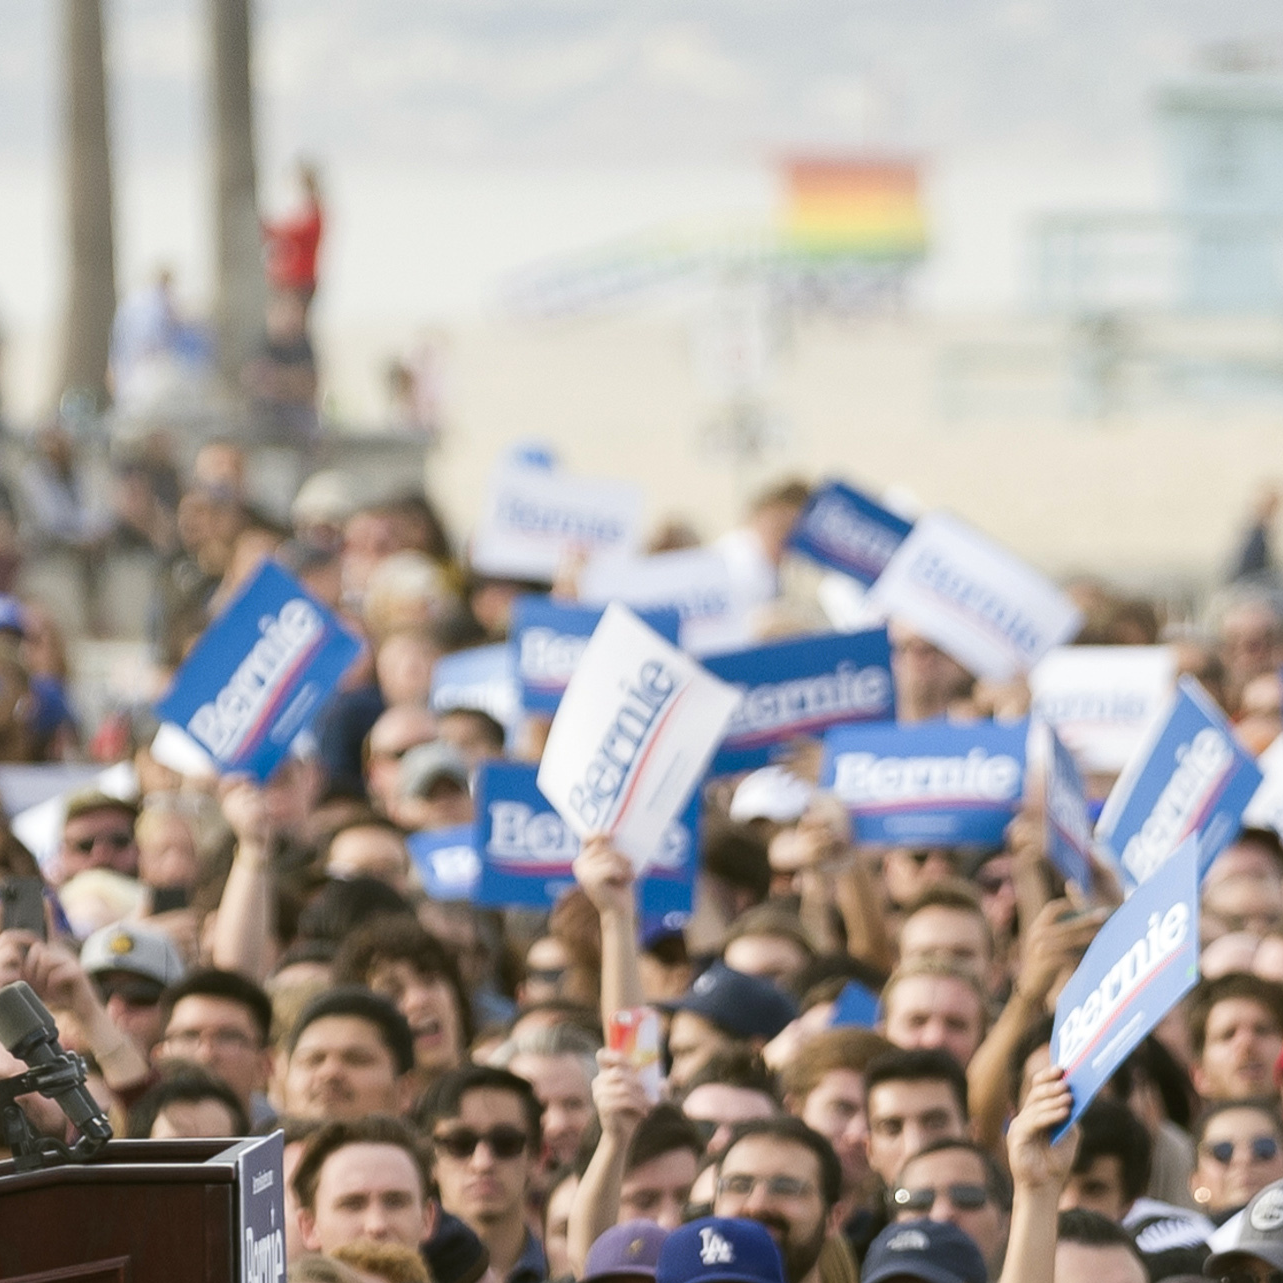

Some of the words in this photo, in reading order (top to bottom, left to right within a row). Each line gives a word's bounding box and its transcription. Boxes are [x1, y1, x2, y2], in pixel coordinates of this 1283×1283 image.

[187, 598, 326, 761] Bernie
[570, 659, 677, 827] Bernie
[834, 748, 1020, 803] Bernie
[1122, 727, 1233, 885] Bernie
[1058, 901, 1189, 1070] Bernie
[698, 1226, 733, 1265] LA
